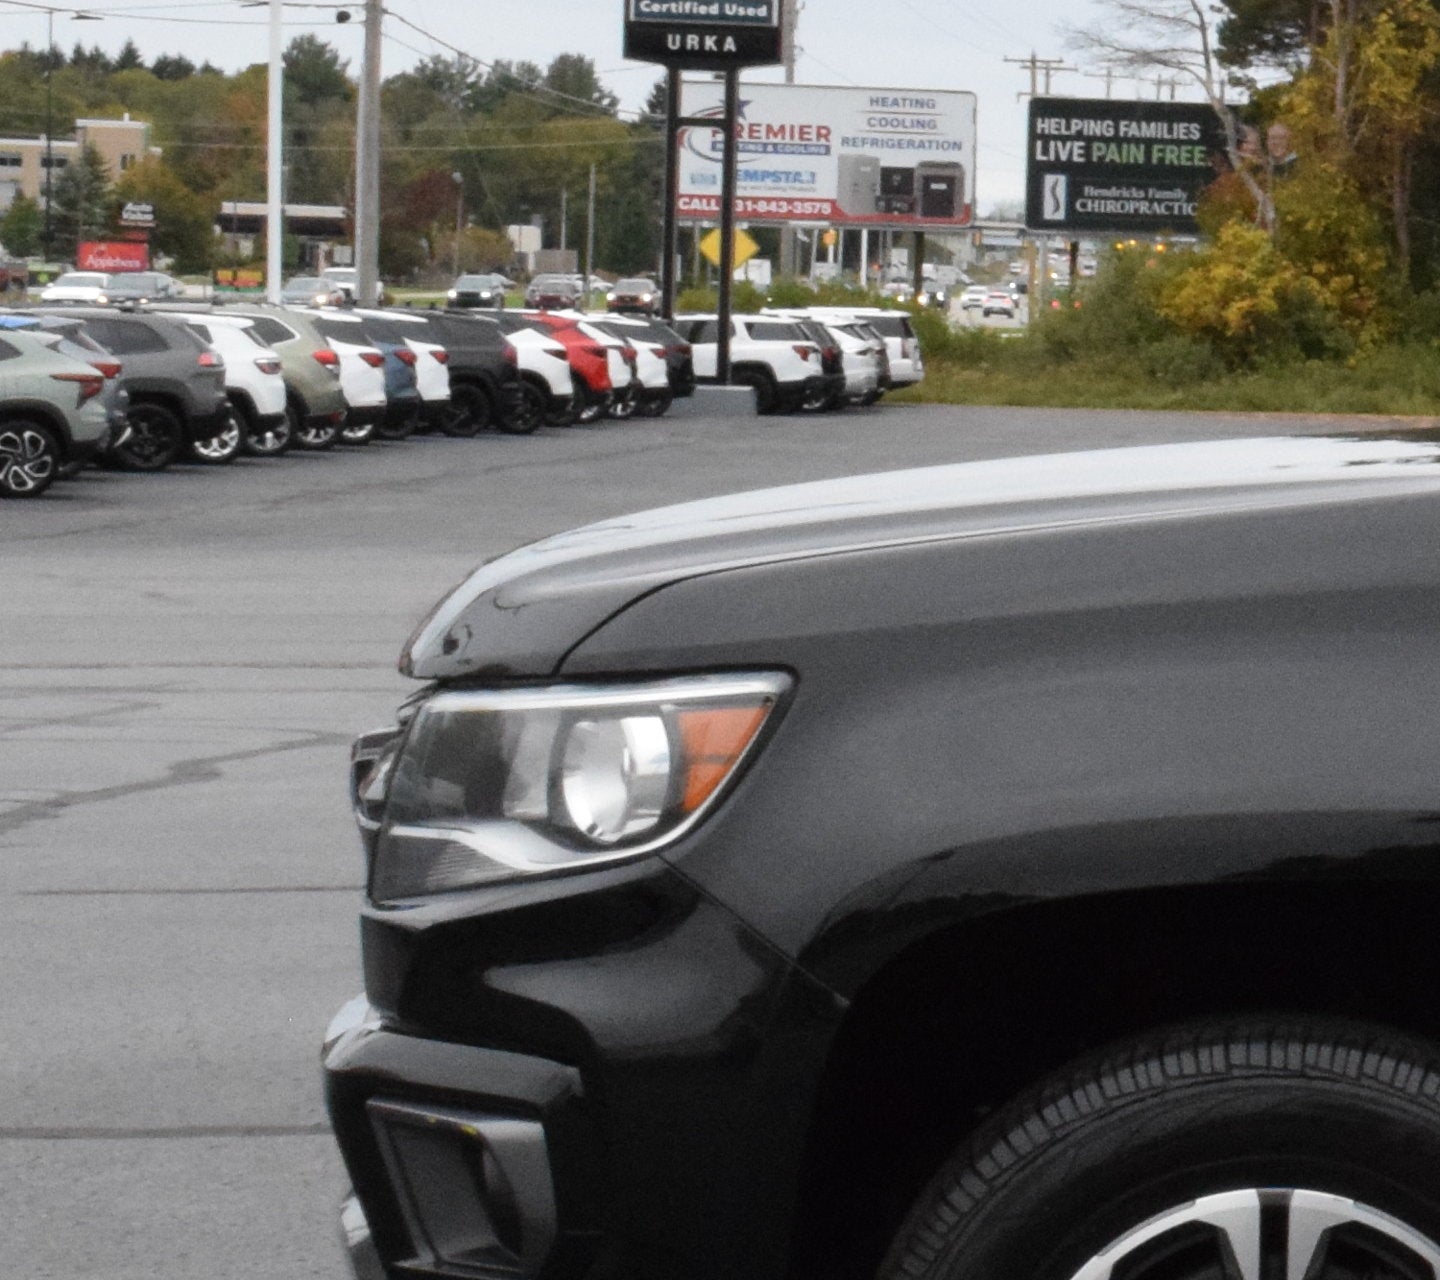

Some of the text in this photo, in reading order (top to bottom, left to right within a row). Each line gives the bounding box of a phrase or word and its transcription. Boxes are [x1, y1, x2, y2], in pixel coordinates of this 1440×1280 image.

[639, 0, 768, 17] Certified Used
[667, 34, 737, 52] URKA
[869, 96, 936, 109] HEATING
[867, 117, 937, 129] COOLING
[1036, 118, 1201, 140] HELPING FAMILIES
[841, 136, 963, 151] REFRIGERATION
[1035, 140, 1086, 162] LIVE
[1092, 142, 1145, 164] PAIN
[678, 197, 720, 211] CALL
[1075, 199, 1198, 216] CHIROPRACTIC
